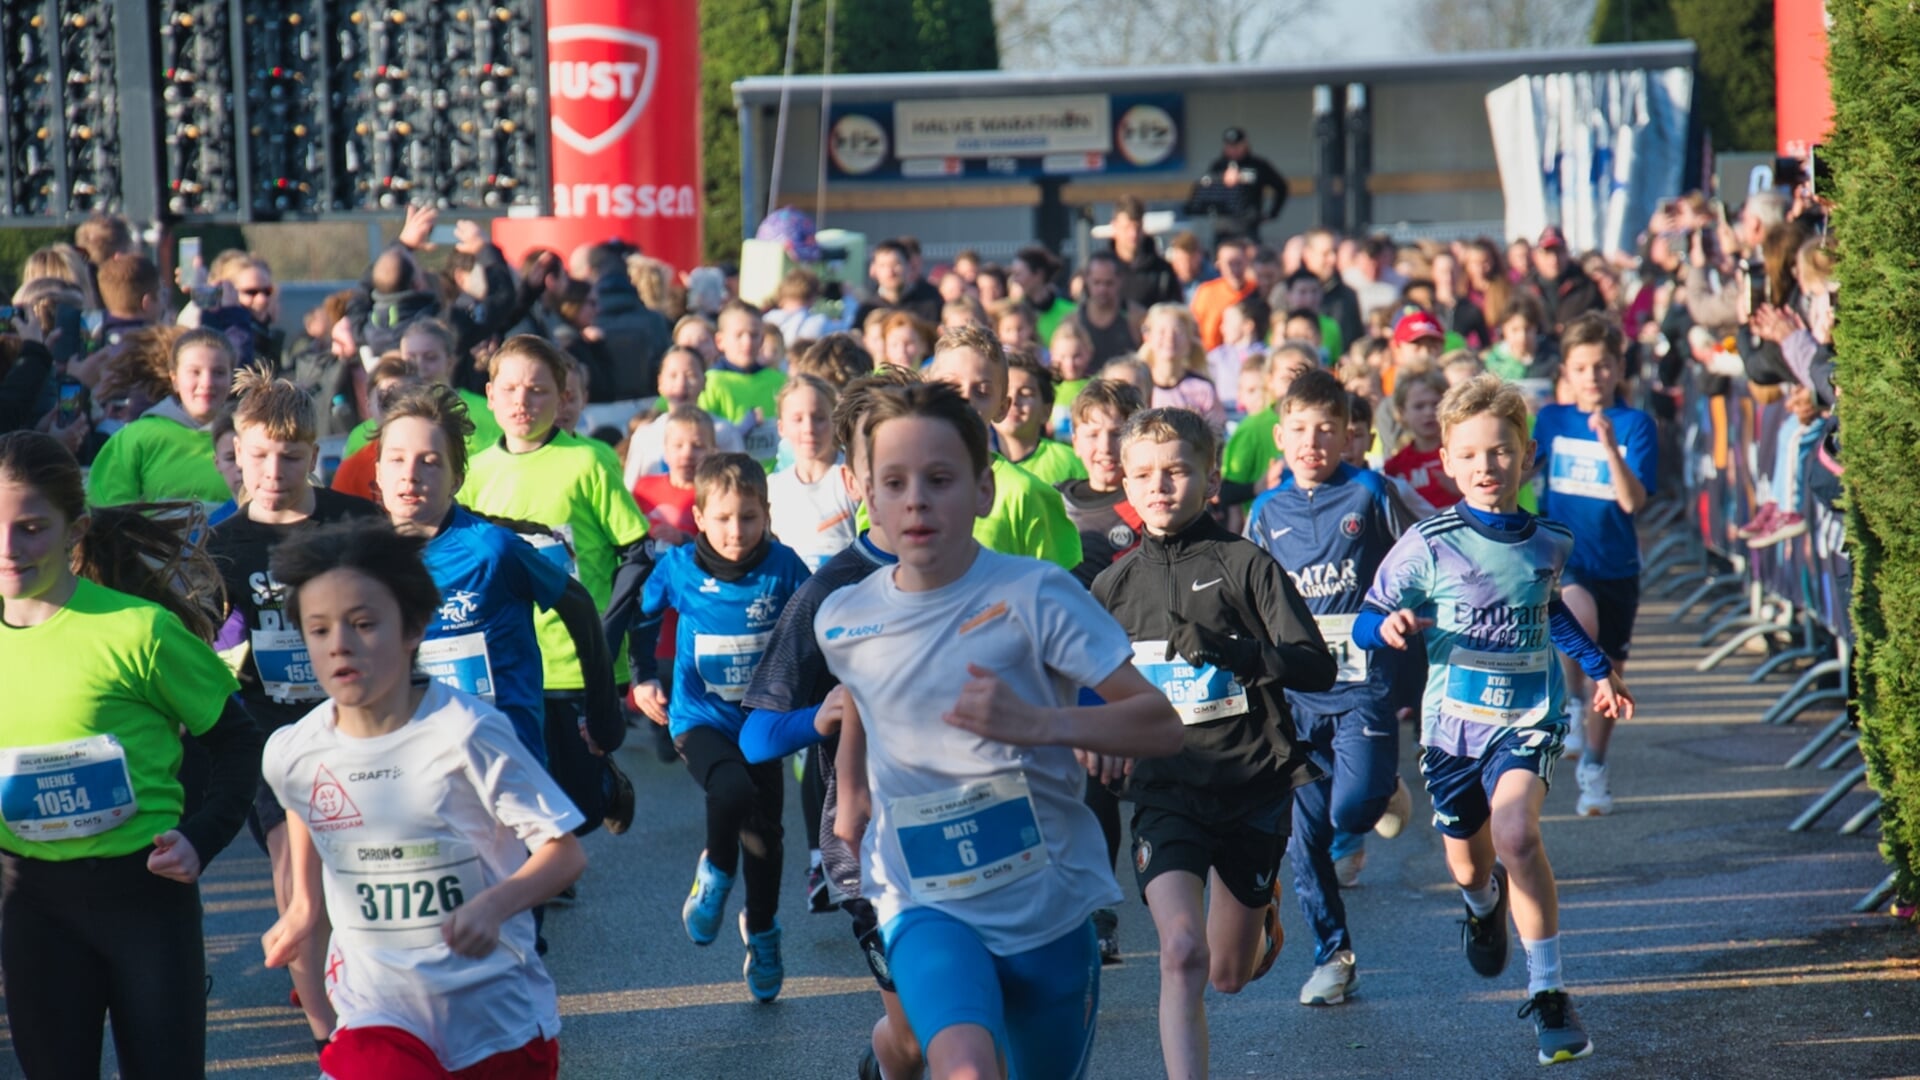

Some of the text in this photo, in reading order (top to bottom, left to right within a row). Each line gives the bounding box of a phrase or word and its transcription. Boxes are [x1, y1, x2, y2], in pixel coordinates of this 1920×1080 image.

[553, 183, 696, 218] arissen
[284, 662, 315, 682] 159
[1480, 687, 1515, 707] 467
[37, 773, 76, 790] NIENKE
[348, 769, 391, 782] CRAFT
[34, 787, 91, 816] 1054
[319, 789, 336, 801] AV
[321, 801, 337, 814] 23
[943, 820, 978, 840] MATS
[957, 839, 979, 867] 6
[356, 875, 465, 921] 37726
